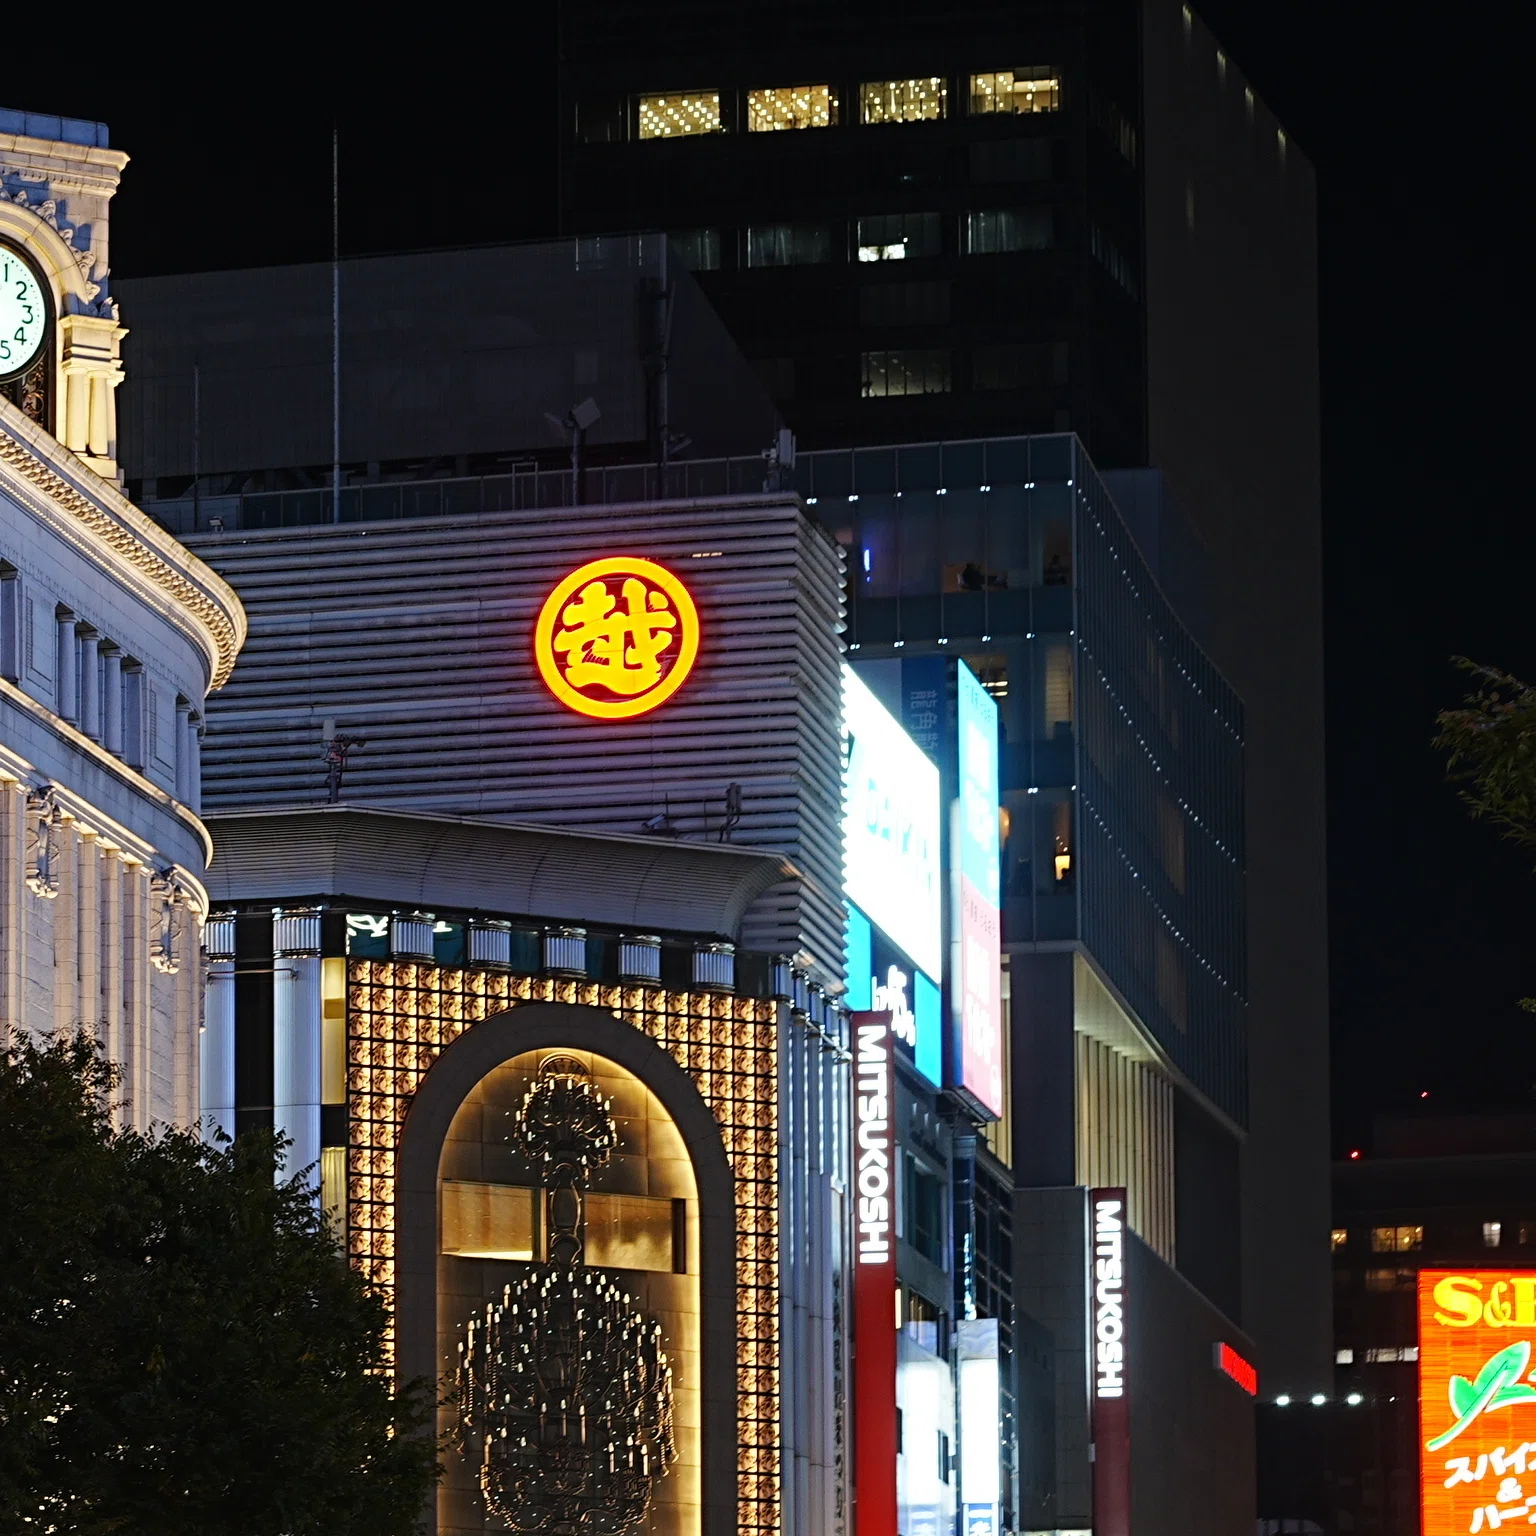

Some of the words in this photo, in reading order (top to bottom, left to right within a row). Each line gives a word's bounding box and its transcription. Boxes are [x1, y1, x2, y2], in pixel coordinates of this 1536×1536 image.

[4, 263, 10, 282] 1
[16, 281, 28, 300] 2
[22, 305, 34, 324] 3
[13, 327, 28, 346] 4
[0, 340, 11, 359] 5
[857, 1025, 888, 1265] MITSUKOSHI
[1096, 1200, 1123, 1399] MITSUKOSHI
[1443, 1442, 1536, 1489] スパイ
[1469, 1497, 1536, 1534] ハー
